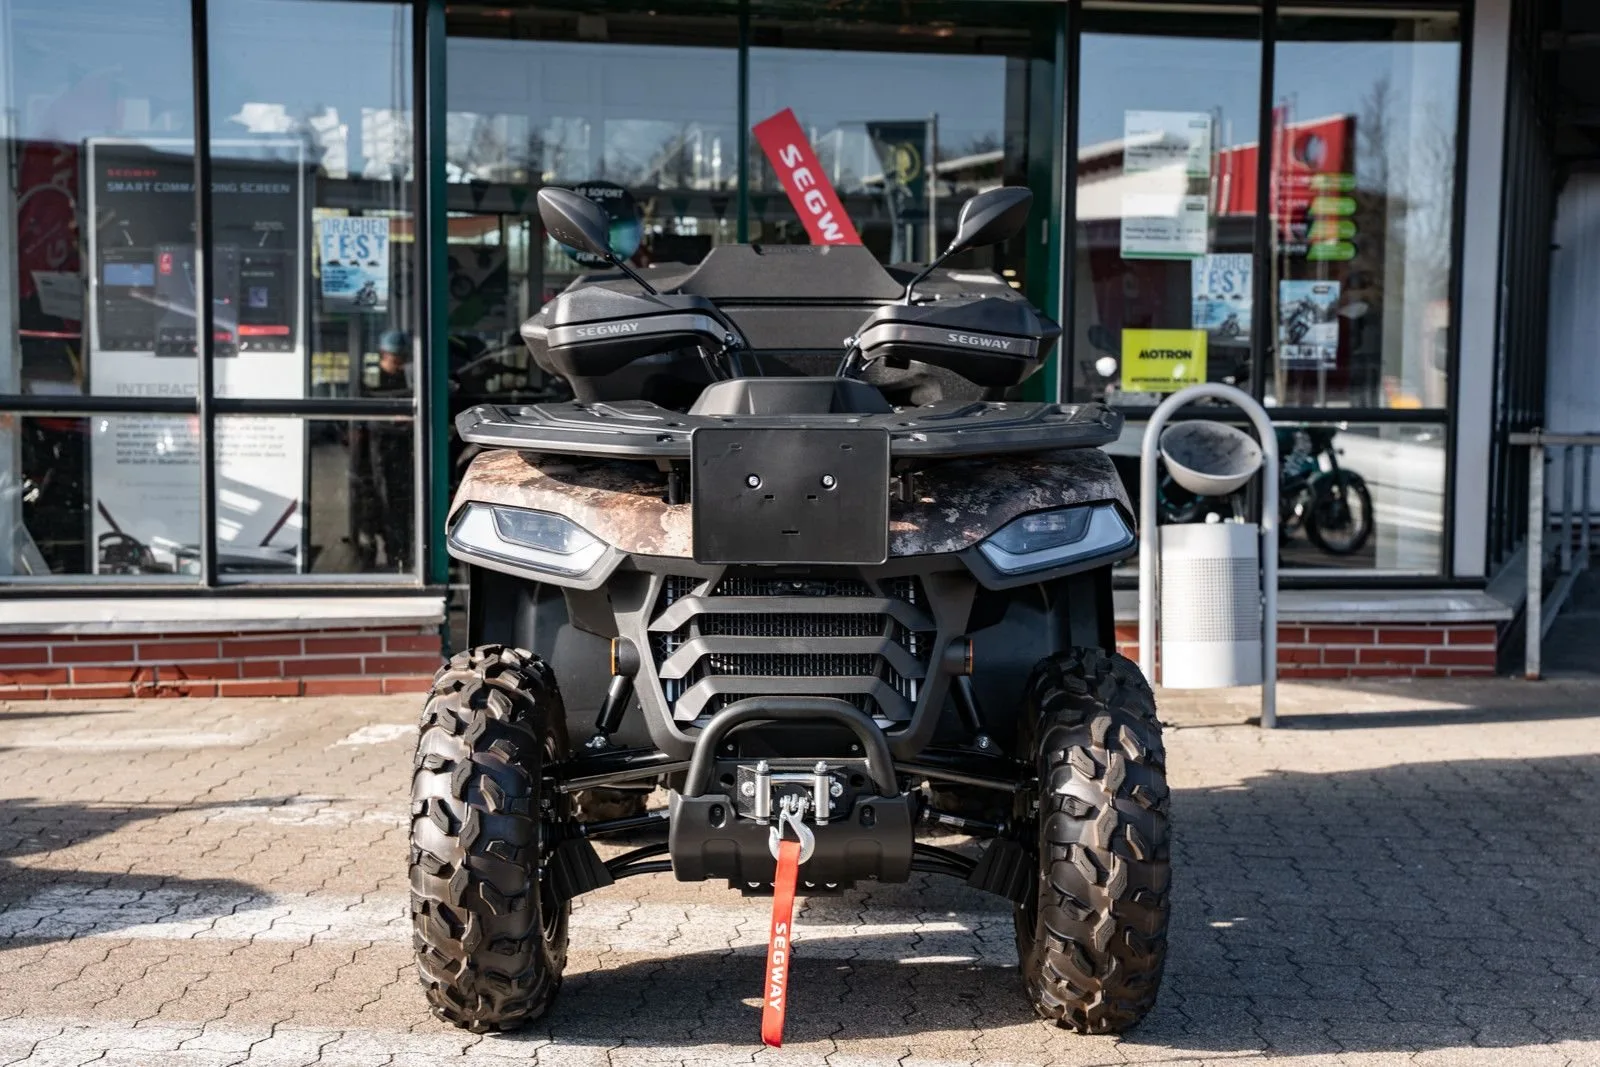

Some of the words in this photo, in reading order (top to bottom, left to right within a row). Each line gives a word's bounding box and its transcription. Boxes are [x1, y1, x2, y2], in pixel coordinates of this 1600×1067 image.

[107, 182, 150, 192] SMART
[153, 182, 237, 193] COMMADING
[240, 182, 290, 193] SCREEN
[588, 188, 623, 198] SOFORT
[778, 143, 847, 245] SEGW
[323, 234, 386, 258] FEST
[576, 322, 639, 337] SEGWAY
[948, 333, 1011, 349] SEGWAY
[1138, 349, 1193, 360] MOTRON
[769, 921, 787, 1012] SEGWAY
